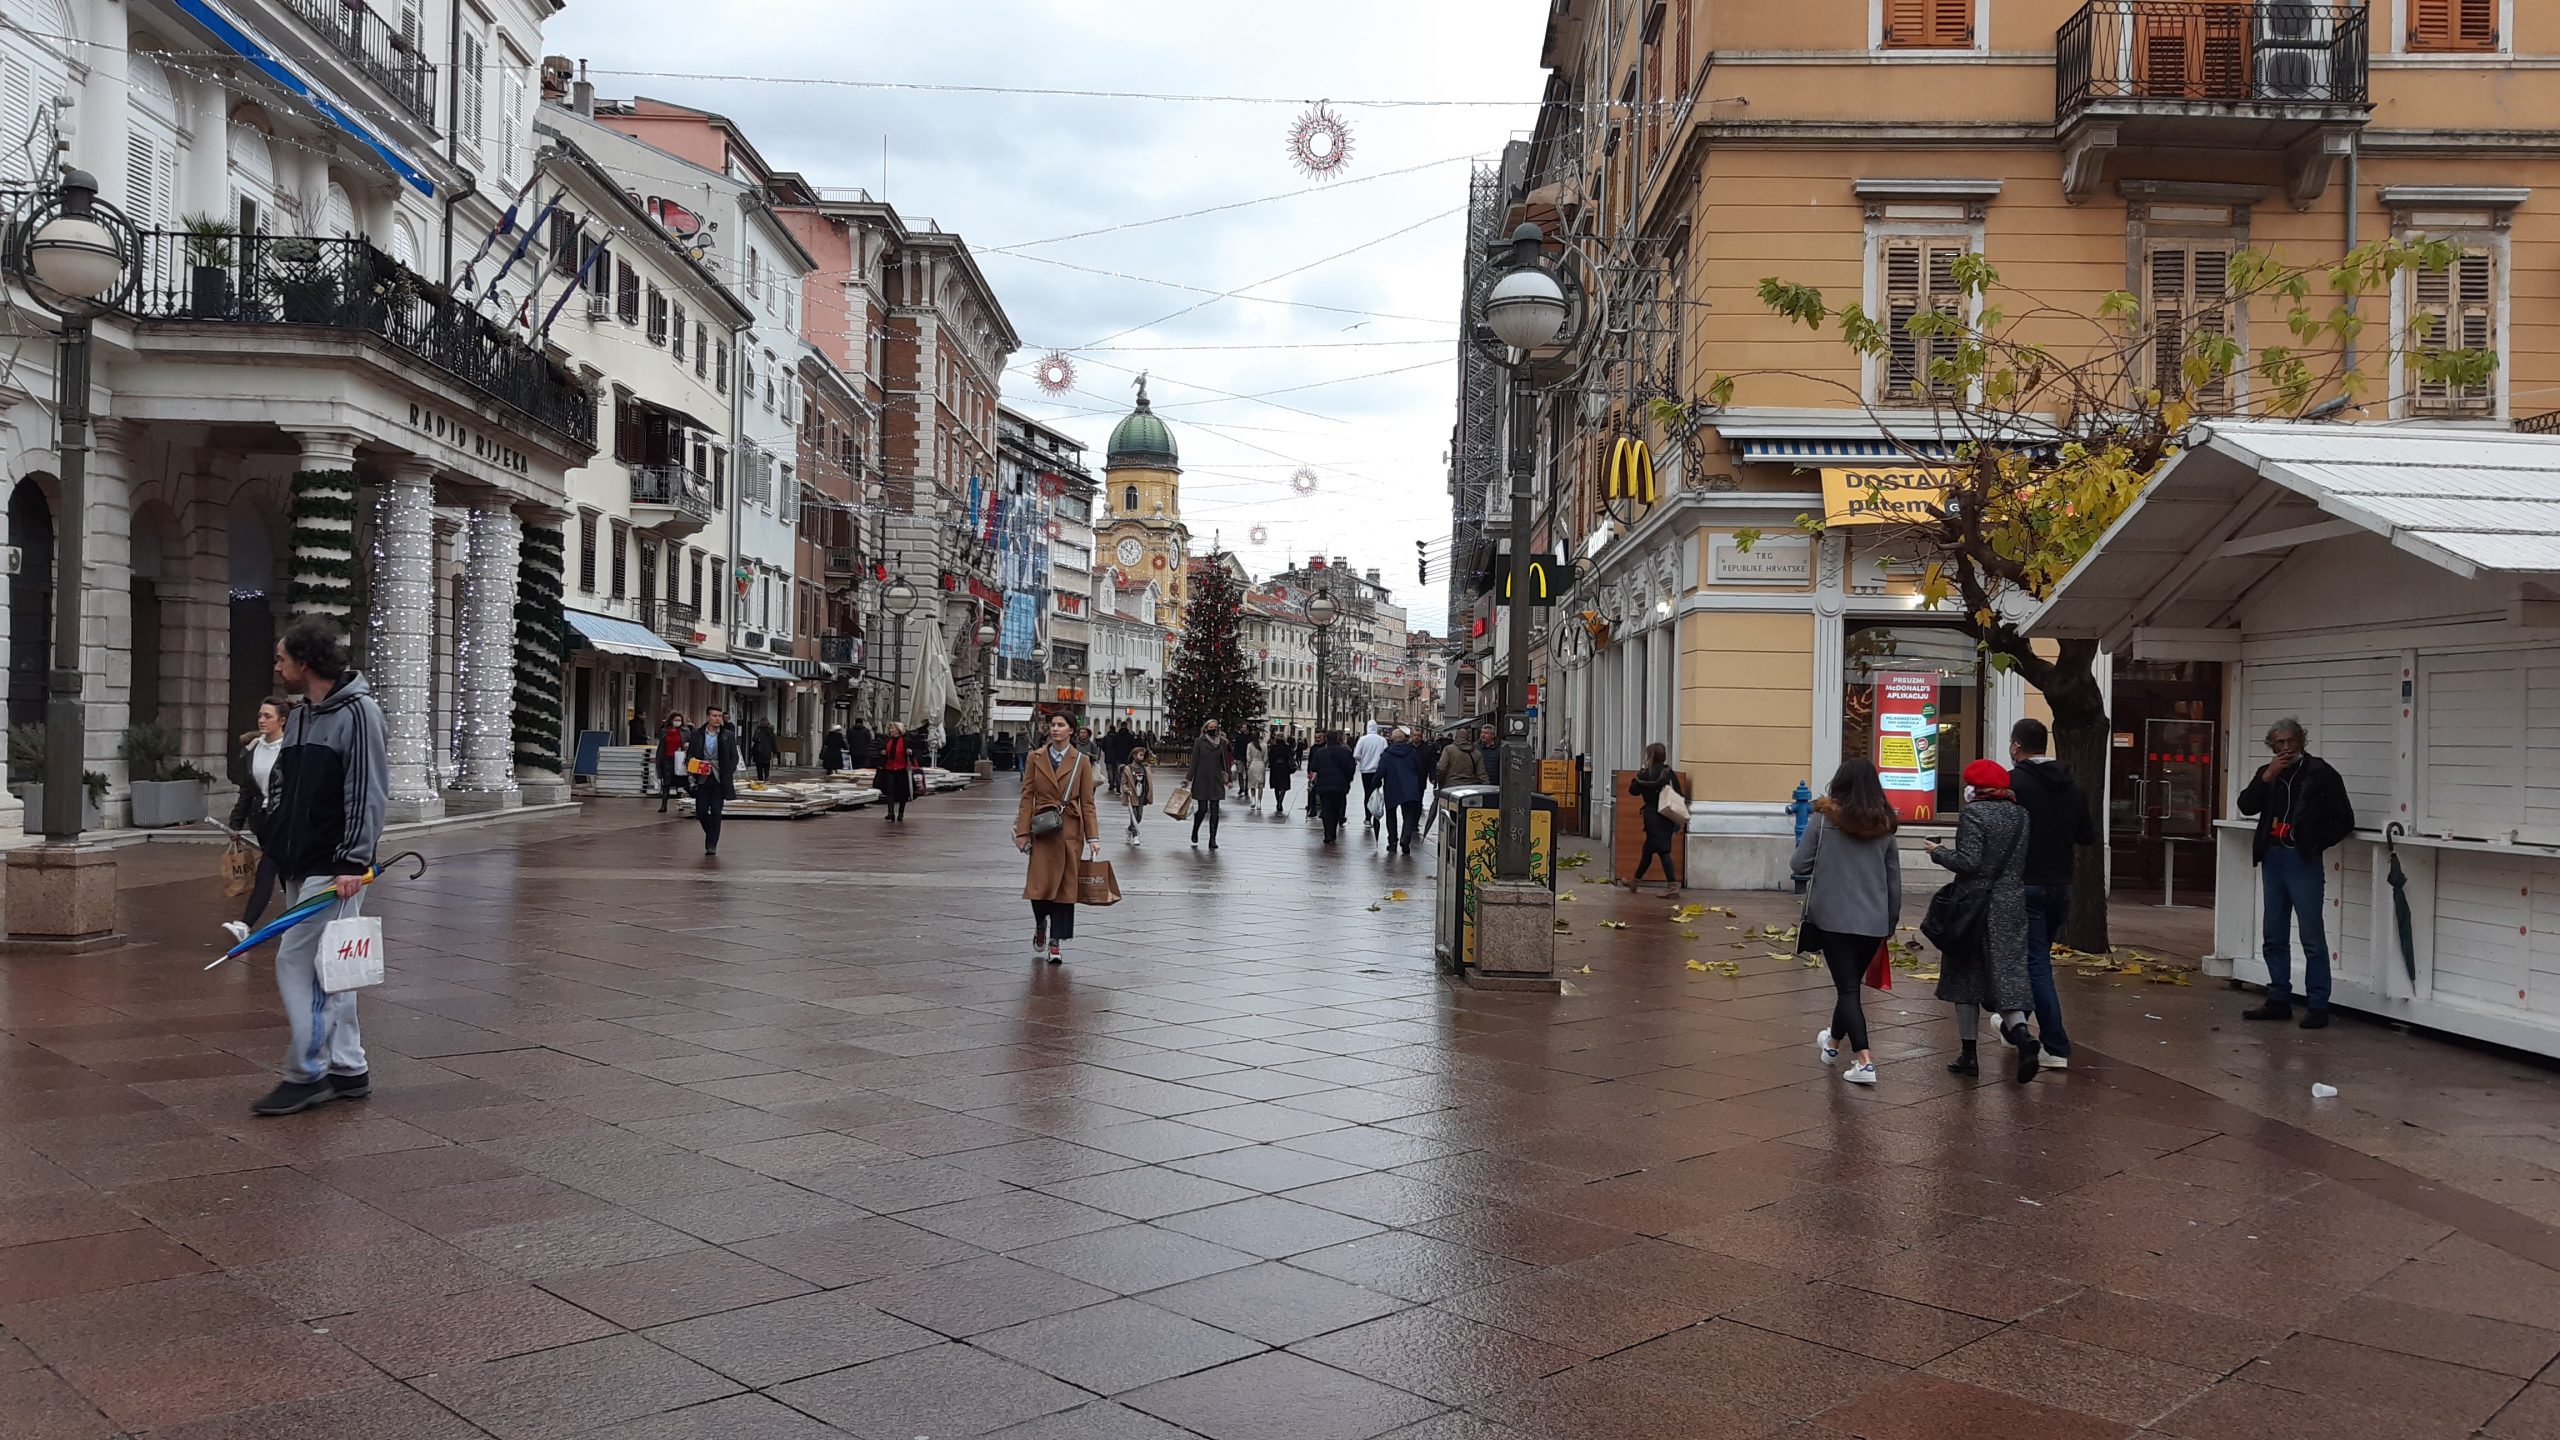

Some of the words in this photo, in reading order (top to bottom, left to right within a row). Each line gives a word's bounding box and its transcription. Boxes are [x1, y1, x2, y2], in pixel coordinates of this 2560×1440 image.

[409, 402, 467, 448] RADIO
[475, 434, 528, 474] RIJEKA
[1845, 473, 1949, 491] DOSTAV
[1848, 498, 1929, 517] putem
[1755, 552, 1774, 560] TRG
[1722, 564, 1763, 573] REPUBLIKE
[1765, 565, 1807, 573] HRVATSKE
[1886, 692, 1929, 700] APLIKACIJU
[337, 937, 371, 961] H&M
